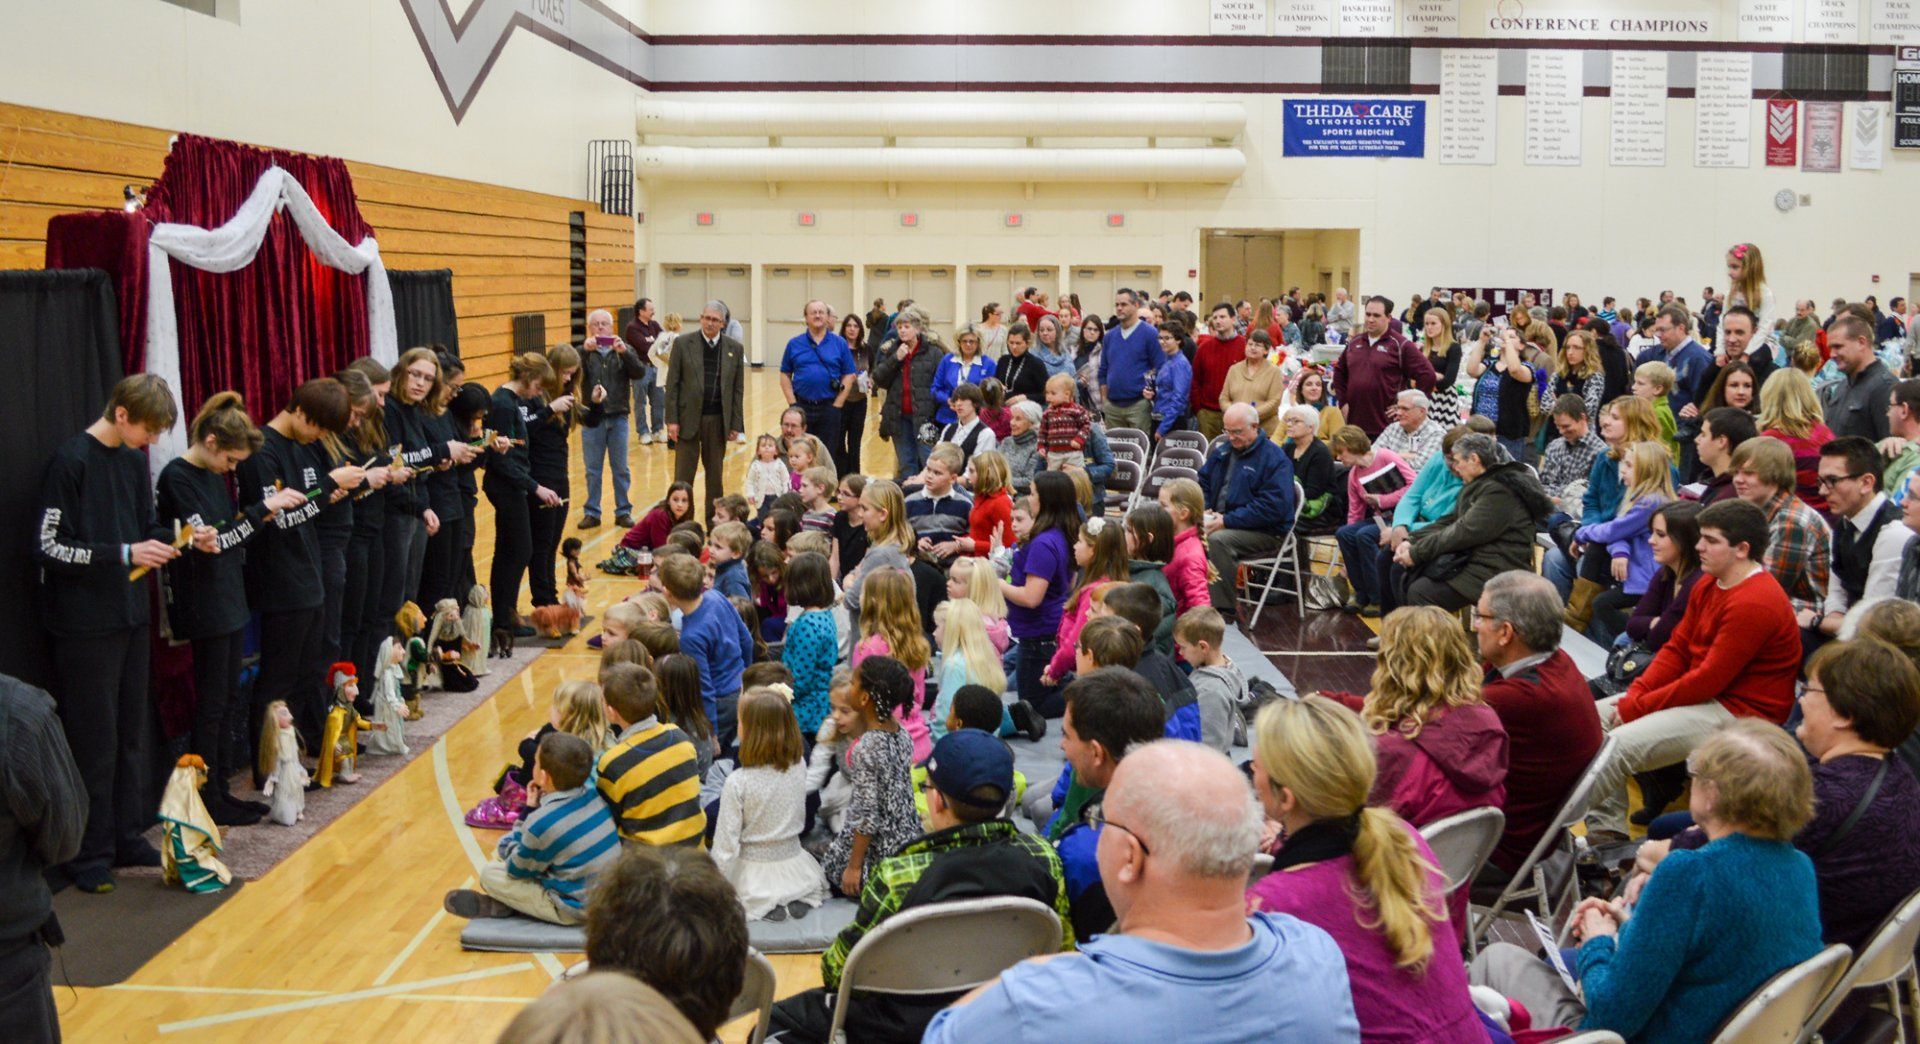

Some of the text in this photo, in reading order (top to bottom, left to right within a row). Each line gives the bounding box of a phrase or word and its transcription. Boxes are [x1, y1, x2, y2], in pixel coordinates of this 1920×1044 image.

[1222, 2, 1254, 10] SOCCER
[1343, 15, 1392, 23] RUNNER-UP
[1490, 17, 1708, 33] CONFERENCE CHAMPIONS
[1306, 118, 1380, 126] ORTHOPEDICS
[1322, 128, 1352, 136] SPORTS
[1172, 440, 1199, 449] FOXES
[1111, 451, 1134, 461] OXES
[1168, 457, 1194, 467] FOXES
[238, 519, 255, 538] FOX
[220, 529, 242, 549] FOLK
